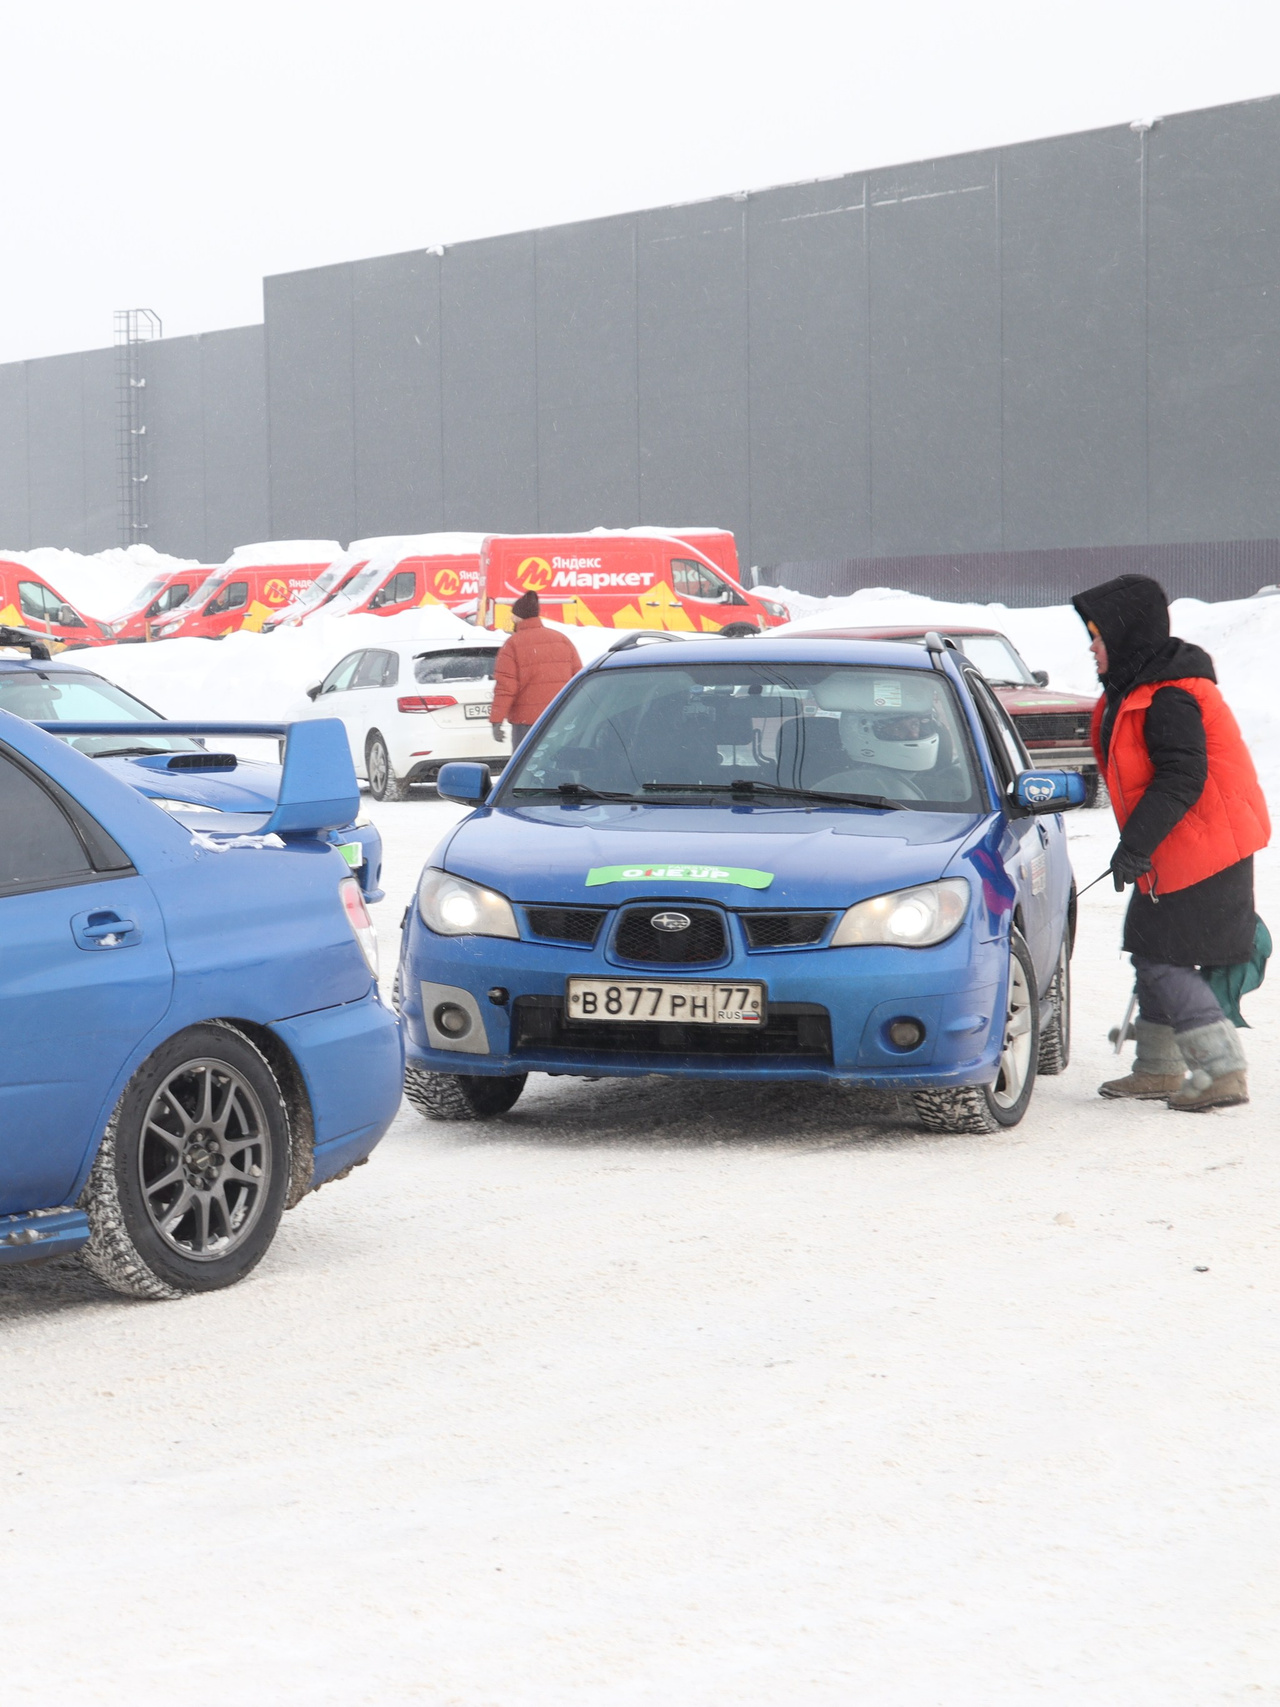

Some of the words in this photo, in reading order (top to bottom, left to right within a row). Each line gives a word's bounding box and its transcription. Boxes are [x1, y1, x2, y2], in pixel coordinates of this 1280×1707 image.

[552, 557, 601, 569] Яндекс
[460, 571, 479, 581] Янд
[551, 571, 654, 589] Маркет
[720, 988, 749, 1010] 77
[718, 1011, 740, 1020] RUS
